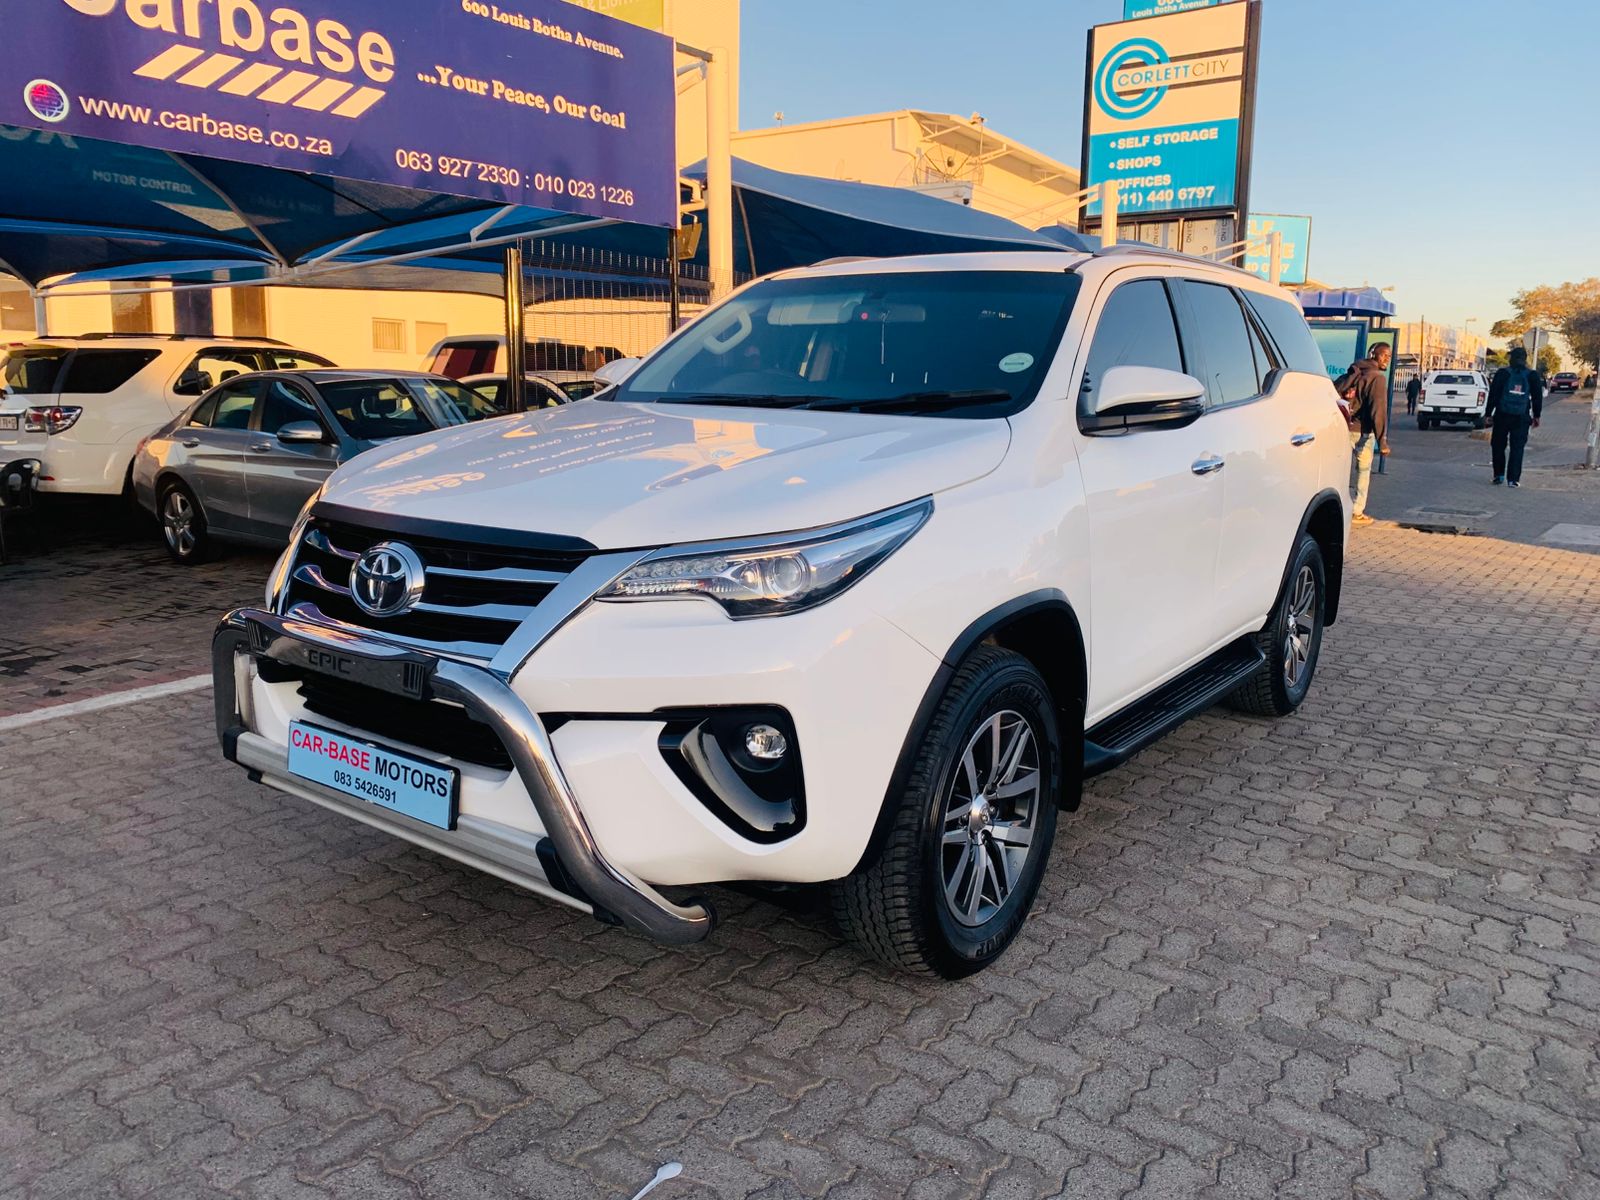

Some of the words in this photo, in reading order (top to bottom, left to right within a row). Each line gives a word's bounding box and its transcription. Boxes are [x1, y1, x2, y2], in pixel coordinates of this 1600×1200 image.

[62, 0, 395, 83] arbase
[462, 0, 489, 18] 600
[492, 6, 531, 29] Louis
[533, 18, 573, 42] Botha
[574, 31, 624, 59] Avenue.
[417, 65, 488, 97] ...Your
[492, 80, 550, 113] Peace,
[553, 95, 587, 119] Our
[589, 105, 626, 129] Goal
[79, 95, 333, 156] www.carbase.co.za
[1117, 135, 1150, 149] SELF
[1153, 128, 1218, 145] STORAGE
[93, 170, 137, 186] MOTOR
[396, 149, 432, 173] 063
[438, 156, 472, 179] 927
[478, 164, 519, 187] 2330
[534, 174, 564, 195] 010
[568, 181, 595, 200] 023
[600, 185, 634, 206] 1226
[1116, 155, 1161, 170] SHOPS
[1147, 189, 1173, 202] 440
[1178, 186, 1215, 200] 6797
[309, 649, 351, 675] EPIC
[292, 729, 370, 771] CAR-BASE
[375, 756, 448, 798] MOTORS
[334, 770, 352, 787] 083
[354, 777, 397, 803] 5426591
